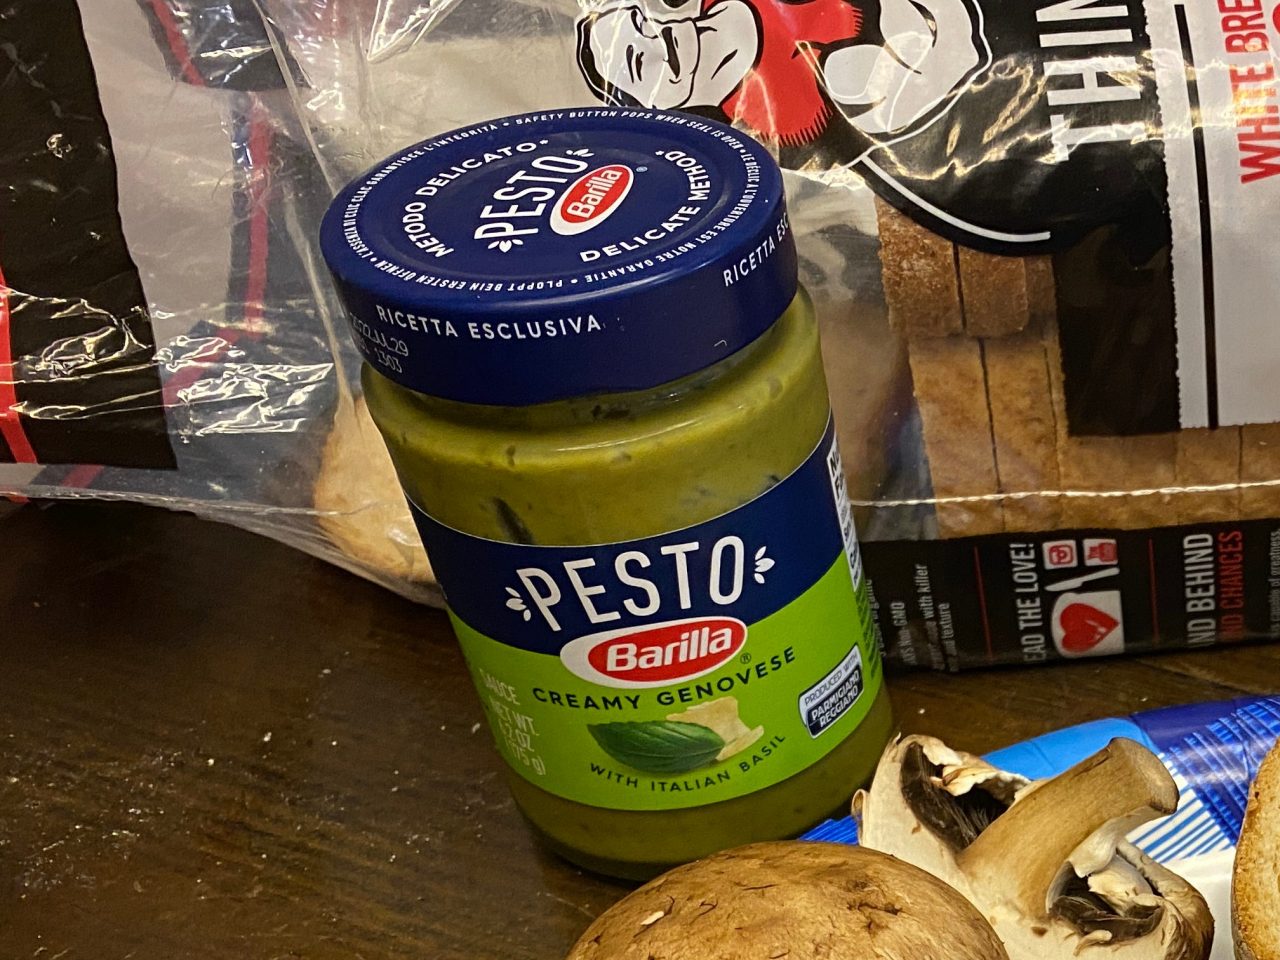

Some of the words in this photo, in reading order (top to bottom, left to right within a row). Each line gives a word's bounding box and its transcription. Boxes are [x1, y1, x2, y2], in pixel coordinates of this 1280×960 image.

[424, 122, 498, 152] L'INTEGRITÀ
[515, 112, 564, 125] SAFETY
[568, 110, 618, 119] BUTTON
[621, 110, 653, 120] POPS
[655, 113, 686, 126] WHEN
[686, 119, 713, 134] SEAL
[710, 127, 724, 140] IS
[721, 133, 743, 150] OPEN
[366, 149, 425, 185] GARANTISCE
[344, 203, 361, 219] CLIC
[351, 186, 373, 202] CLAC
[473, 156, 589, 240] PESTO
[566, 169, 622, 219] Barilla
[402, 201, 455, 258] METODO
[579, 205, 701, 262] DELICATE
[696, 229, 718, 244] EST
[374, 257, 416, 281] ÖFFNEN
[585, 258, 655, 284] GARANTIE
[658, 242, 697, 263] NOTRE
[723, 235, 776, 287] RICETTA
[416, 273, 467, 290] ERSTEN
[507, 279, 564, 292] PLOPPT
[376, 304, 459, 338] RICETTA
[467, 314, 602, 340] ESCLUSIVA
[515, 535, 745, 632] PESTO
[914, 563, 931, 593] killer
[1009, 543, 1039, 593] LOVE!
[1182, 533, 1215, 613] BEHIND
[1219, 530, 1244, 609] CHANCES
[1268, 577, 1280, 587] of
[919, 595, 935, 619] with
[938, 602, 954, 639] texture
[1017, 597, 1043, 630] THE
[606, 626, 732, 672] Barilla
[532, 687, 641, 710] CREAMY
[656, 646, 795, 706] GENOVESE
[804, 670, 843, 707] PRODUCED
[843, 652, 858, 672] WITH
[811, 669, 860, 721] PARMIGIANO
[819, 684, 859, 728] REGGIANO
[590, 762, 639, 788] WITH
[651, 771, 731, 793] ITALIAN
[738, 734, 786, 773] BASIL
